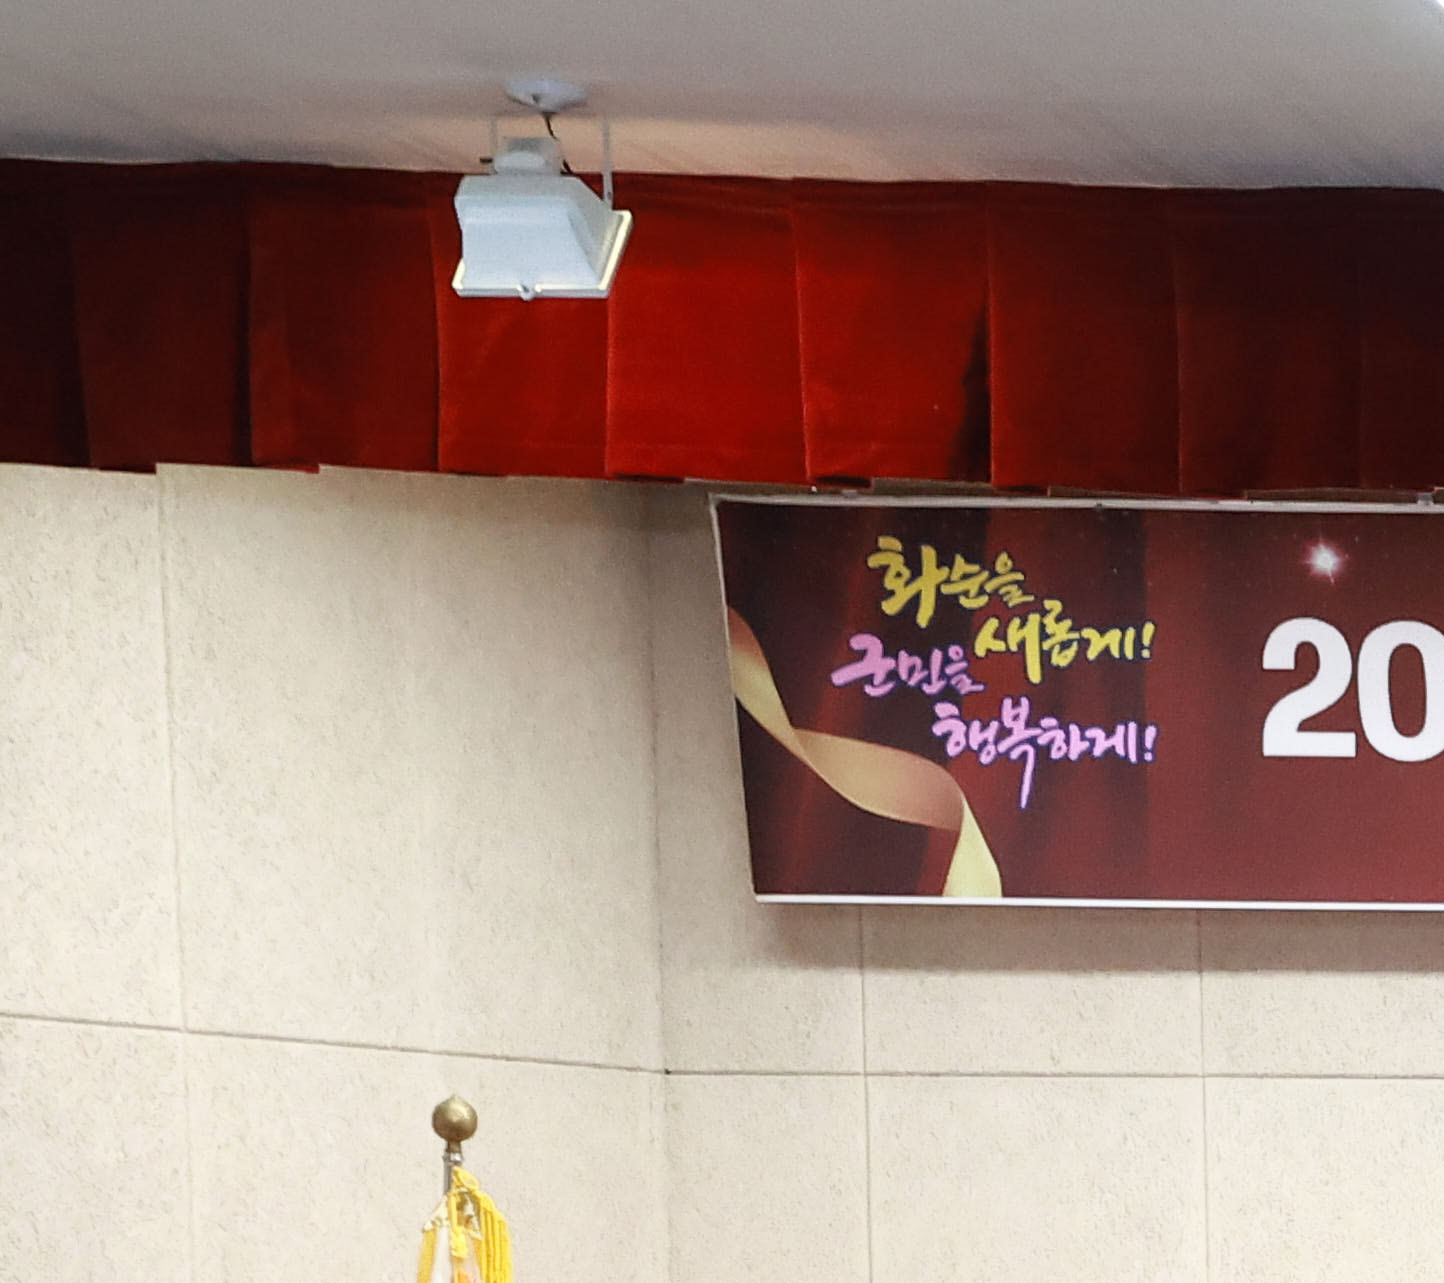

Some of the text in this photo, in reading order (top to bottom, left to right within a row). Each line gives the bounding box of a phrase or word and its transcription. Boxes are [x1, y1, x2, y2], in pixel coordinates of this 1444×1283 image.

[867, 535, 1034, 629] 화순을
[830, 632, 985, 698] 군민을
[932, 695, 1158, 810] 행복하게!
